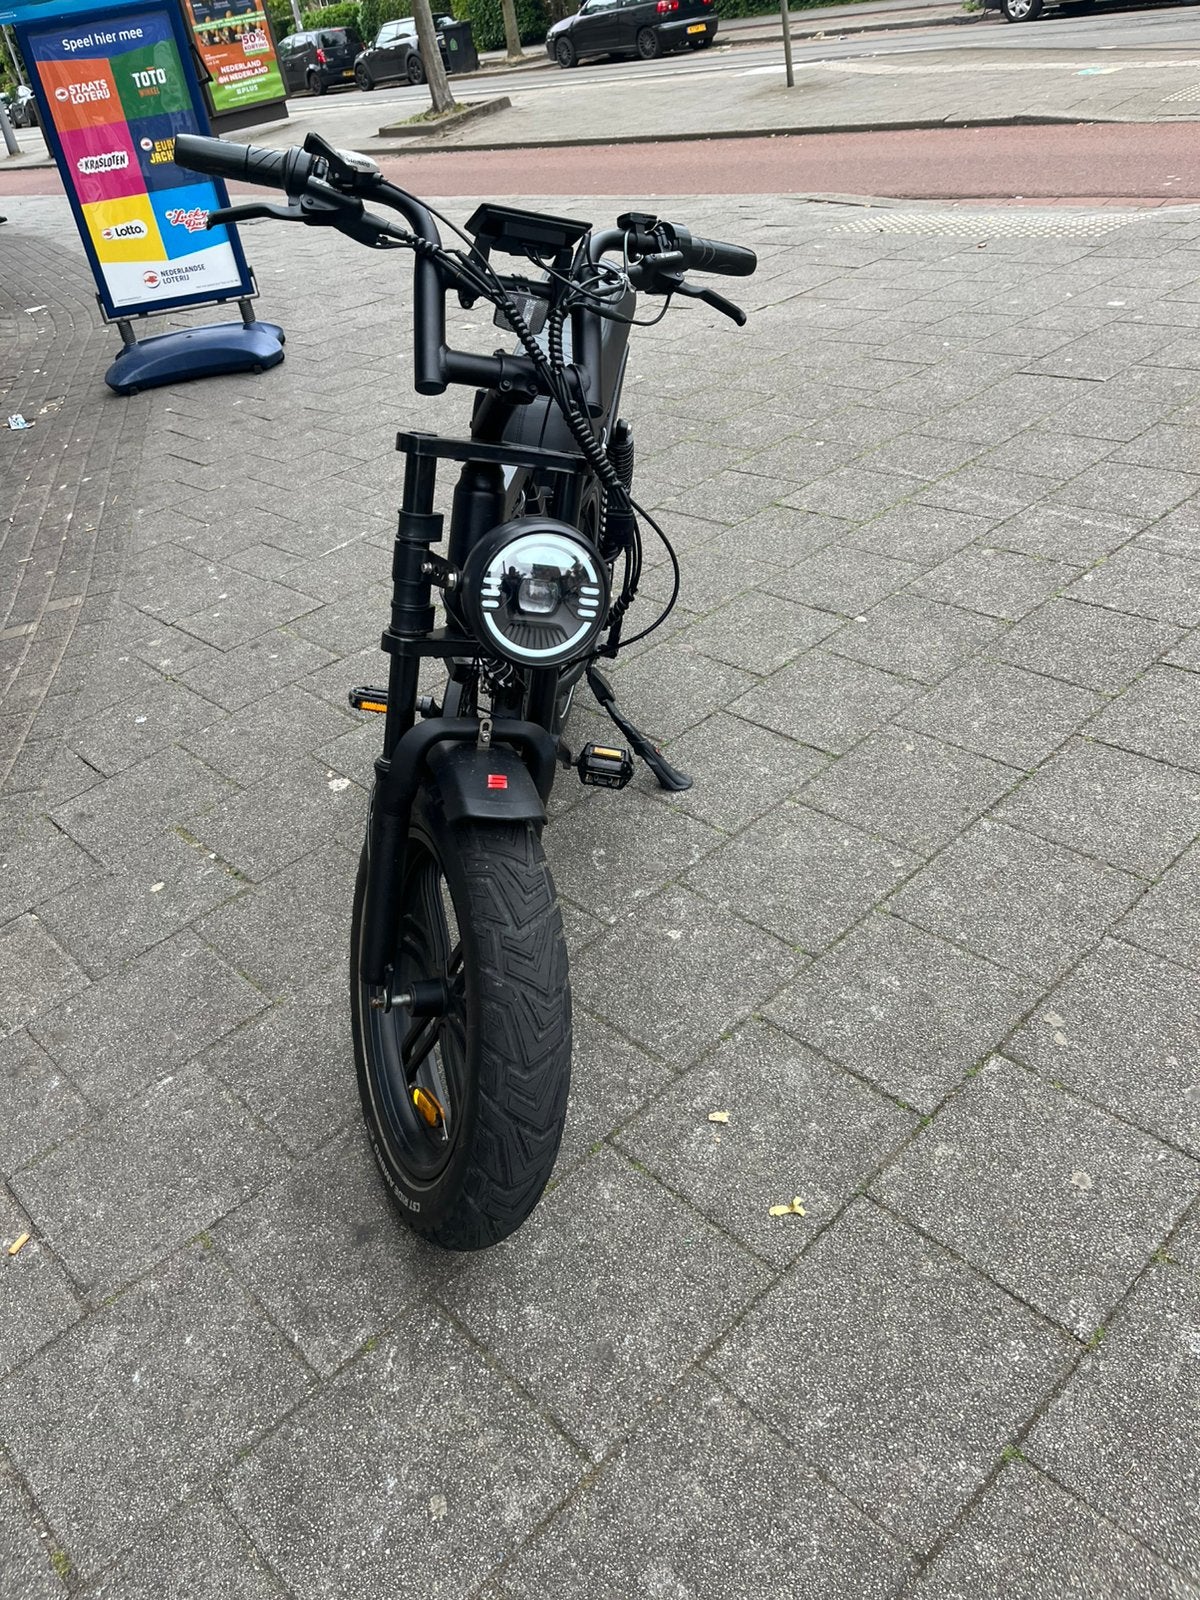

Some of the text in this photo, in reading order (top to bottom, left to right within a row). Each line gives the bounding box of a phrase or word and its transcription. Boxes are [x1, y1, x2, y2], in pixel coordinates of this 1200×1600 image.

[62, 28, 143, 52] Speel hier mee
[243, 29, 266, 45] 50%
[220, 60, 261, 74] NEDERLAND
[229, 66, 268, 81] NEDERLAND
[132, 67, 167, 88] TOTO
[68, 79, 107, 95] STAATS
[138, 86, 160, 97] WINKEL
[242, 85, 258, 94] PLUS
[71, 88, 111, 105] LOTERIJ
[154, 137, 175, 152] EUR
[84, 154, 126, 171] KRASLOTEN
[150, 149, 175, 164] JACK
[172, 209, 207, 225] Lucky
[161, 264, 206, 278] NEDERLANDSE
[162, 275, 190, 285] LOTERIJ
